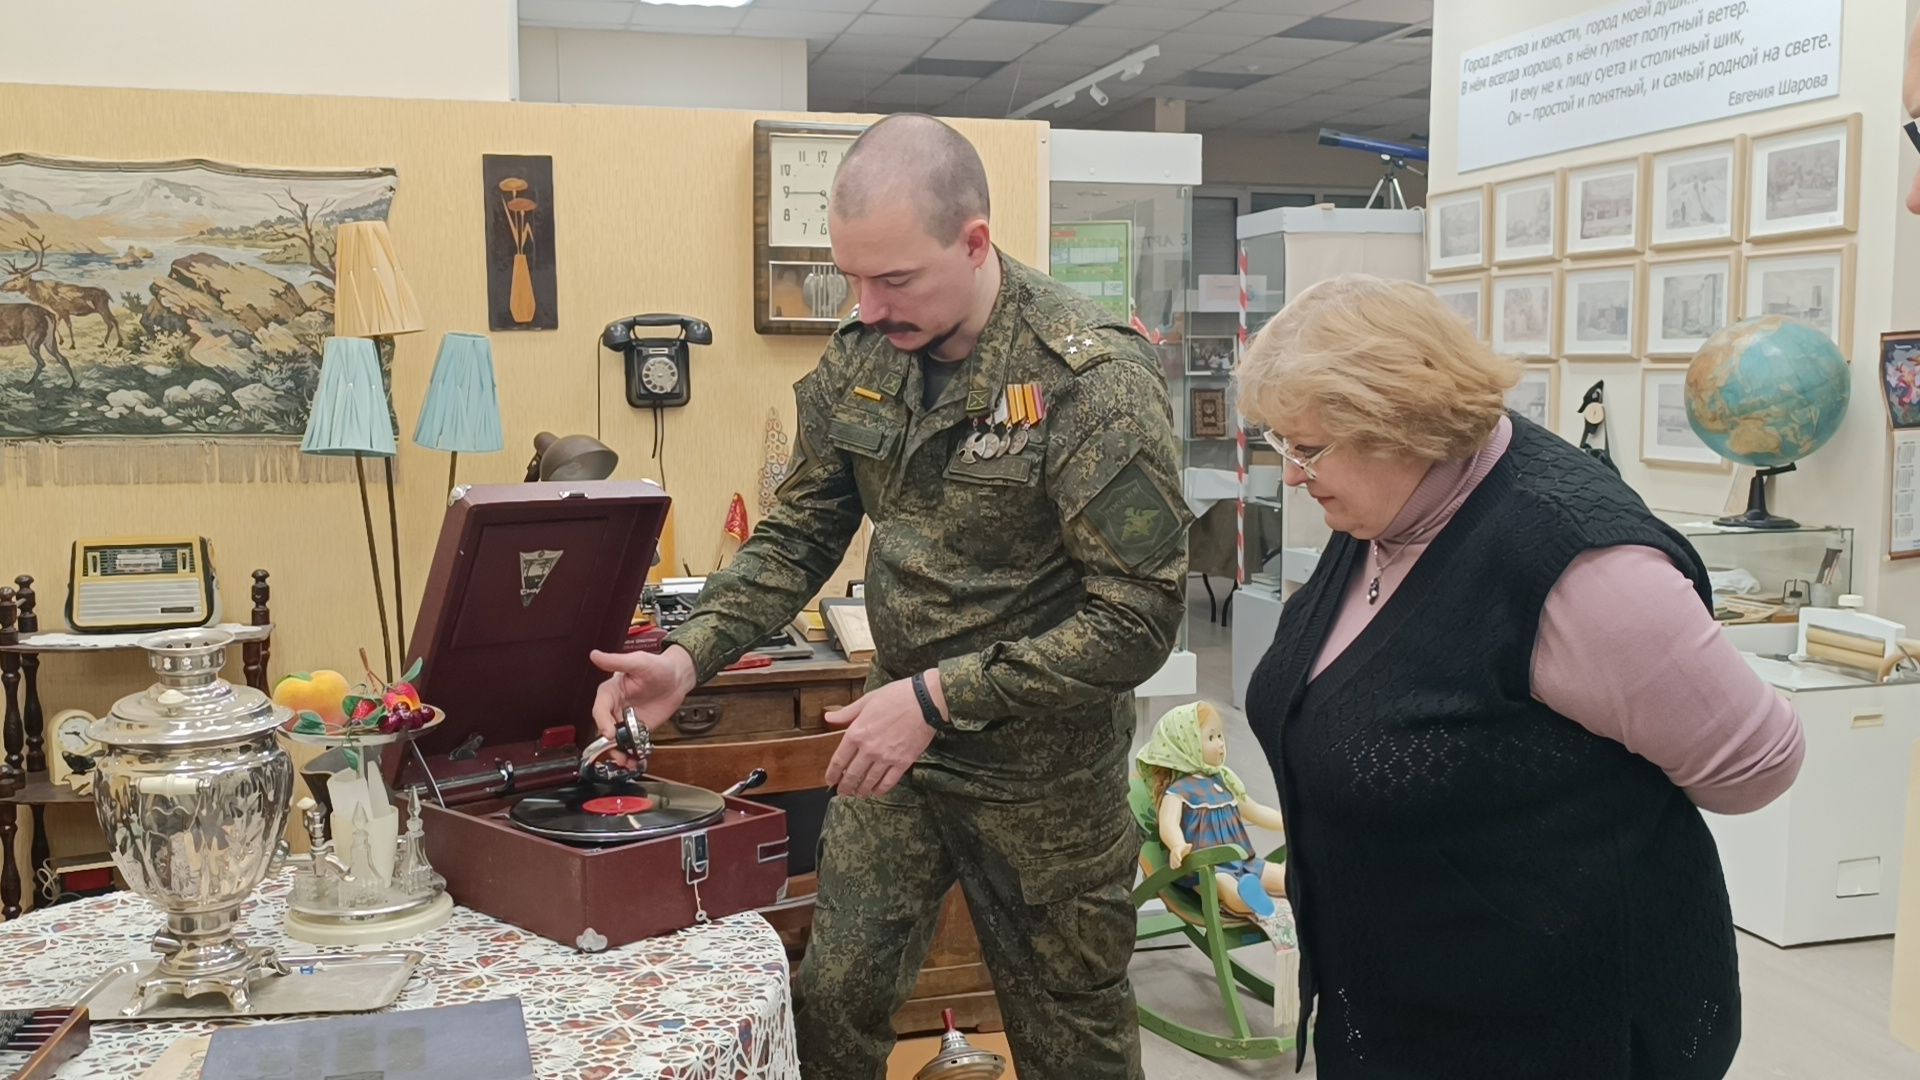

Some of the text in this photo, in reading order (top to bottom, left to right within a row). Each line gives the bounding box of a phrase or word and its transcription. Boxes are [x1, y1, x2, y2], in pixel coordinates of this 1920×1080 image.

[1463, 54, 1490, 74] Город
[1491, 44, 1529, 66] детства
[1531, 40, 1539, 52] и
[1540, 26, 1582, 49] юности,
[1585, 14, 1619, 36] город
[1621, 2, 1652, 21] моей
[1460, 0, 1749, 96] В нём всегда хорошо, в нём гуляет попутный ветер.
[1510, 29, 1745, 103] И ему не к лицу суета и столичный шик,
[1507, 110, 1522, 126] Он
[1532, 95, 1576, 123] простой
[1577, 94, 1585, 109] и
[1587, 76, 1647, 107] понятный,
[1651, 76, 1660, 91] и
[1663, 61, 1704, 89] самый
[1707, 47, 1759, 82] родной
[1761, 45, 1780, 63] на
[1784, 33, 1832, 58] свете.
[1728, 73, 1829, 107] Евгения Шарова
[799, 151, 807, 163] 11
[817, 150, 828, 163] 12
[780, 164, 791, 177] 10
[783, 186, 790, 199] 9
[783, 208, 791, 222] 8
[802, 223, 808, 235] 7
[820, 223, 828, 235] 6
